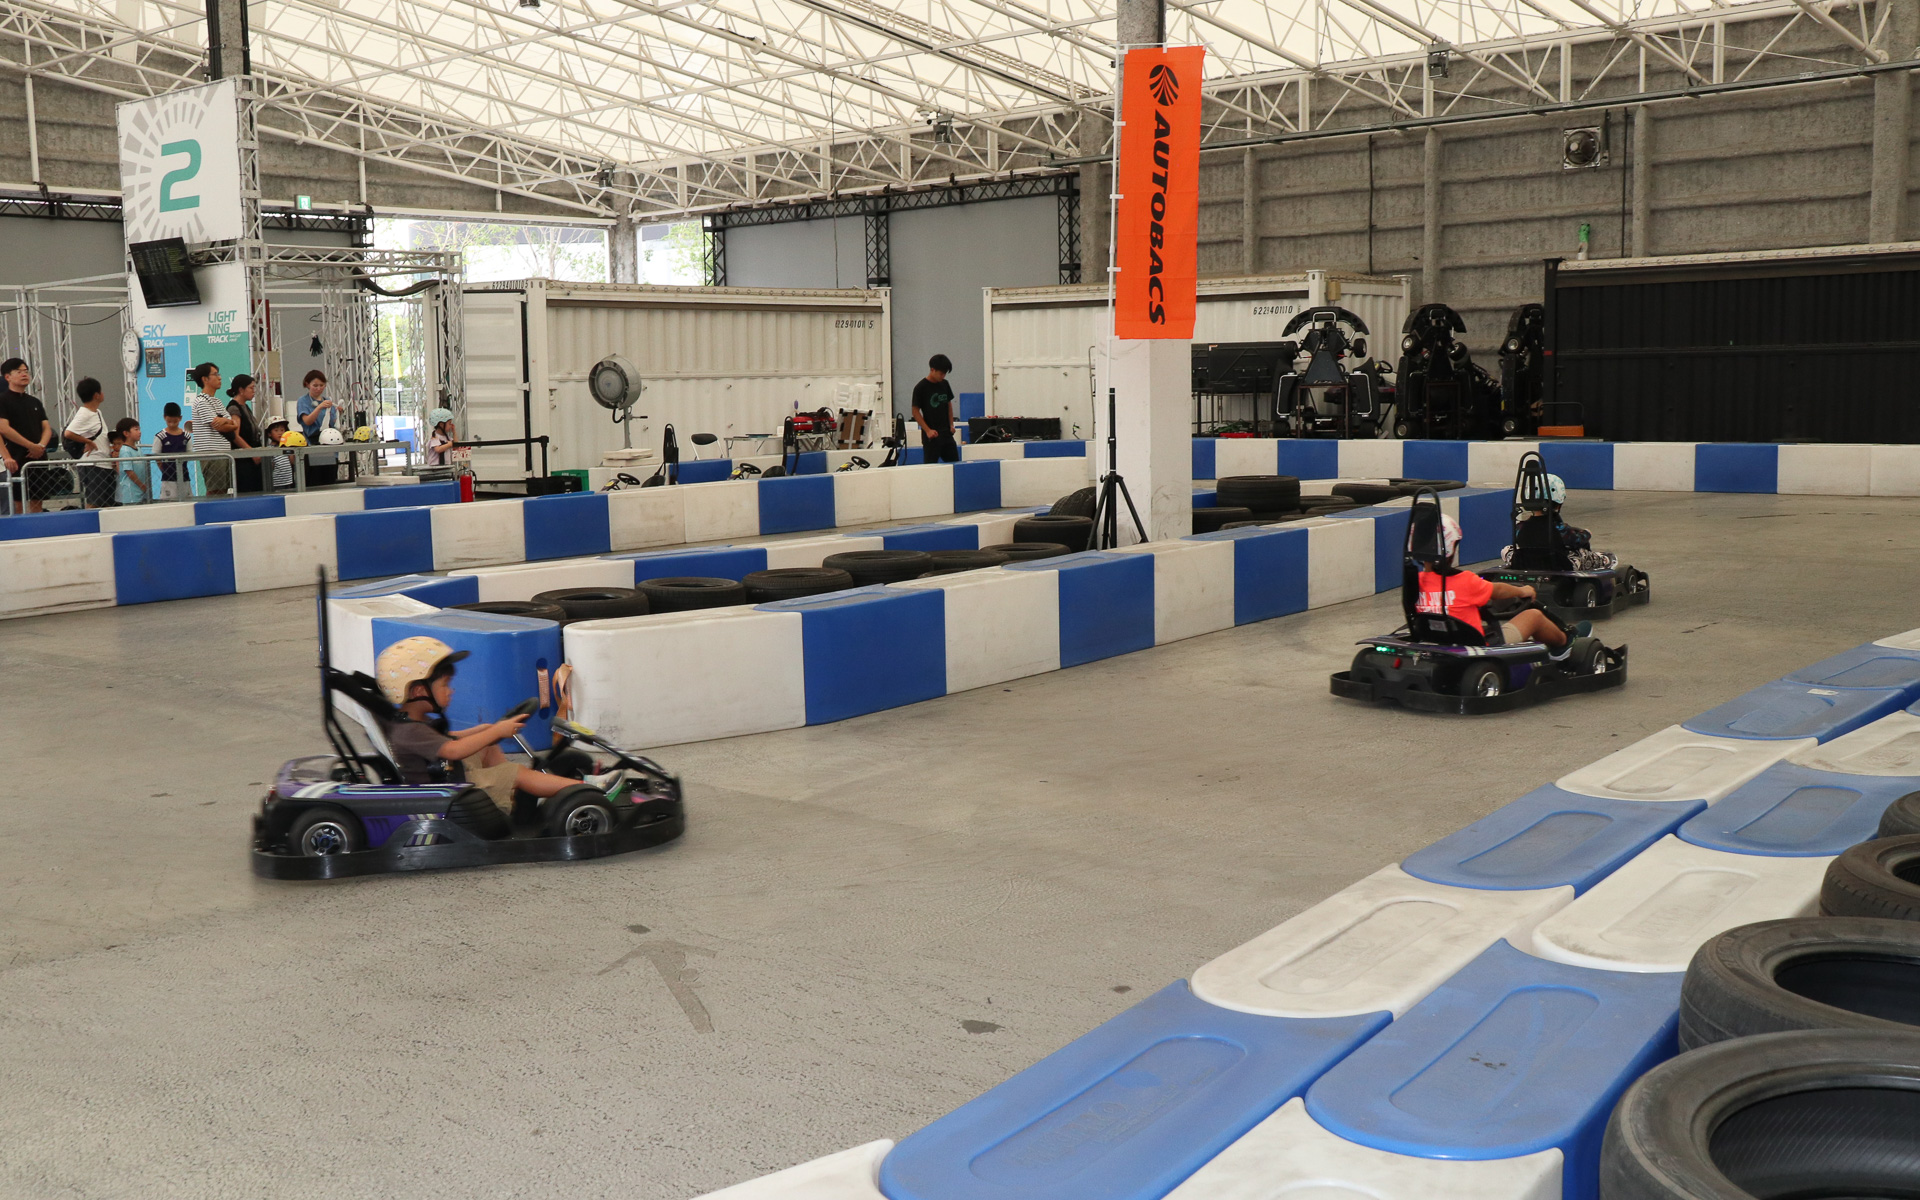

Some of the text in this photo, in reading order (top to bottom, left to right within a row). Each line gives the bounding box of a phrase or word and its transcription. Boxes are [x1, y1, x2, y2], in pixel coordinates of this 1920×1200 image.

[159, 138, 202, 213] 2
[1148, 109, 1171, 326] AUTOBACS
[208, 310, 237, 323] LIGHT
[143, 324, 166, 338] SKY
[207, 323, 230, 335] NING
[142, 339, 164, 348] TRACK
[207, 334, 228, 344] TRACK
